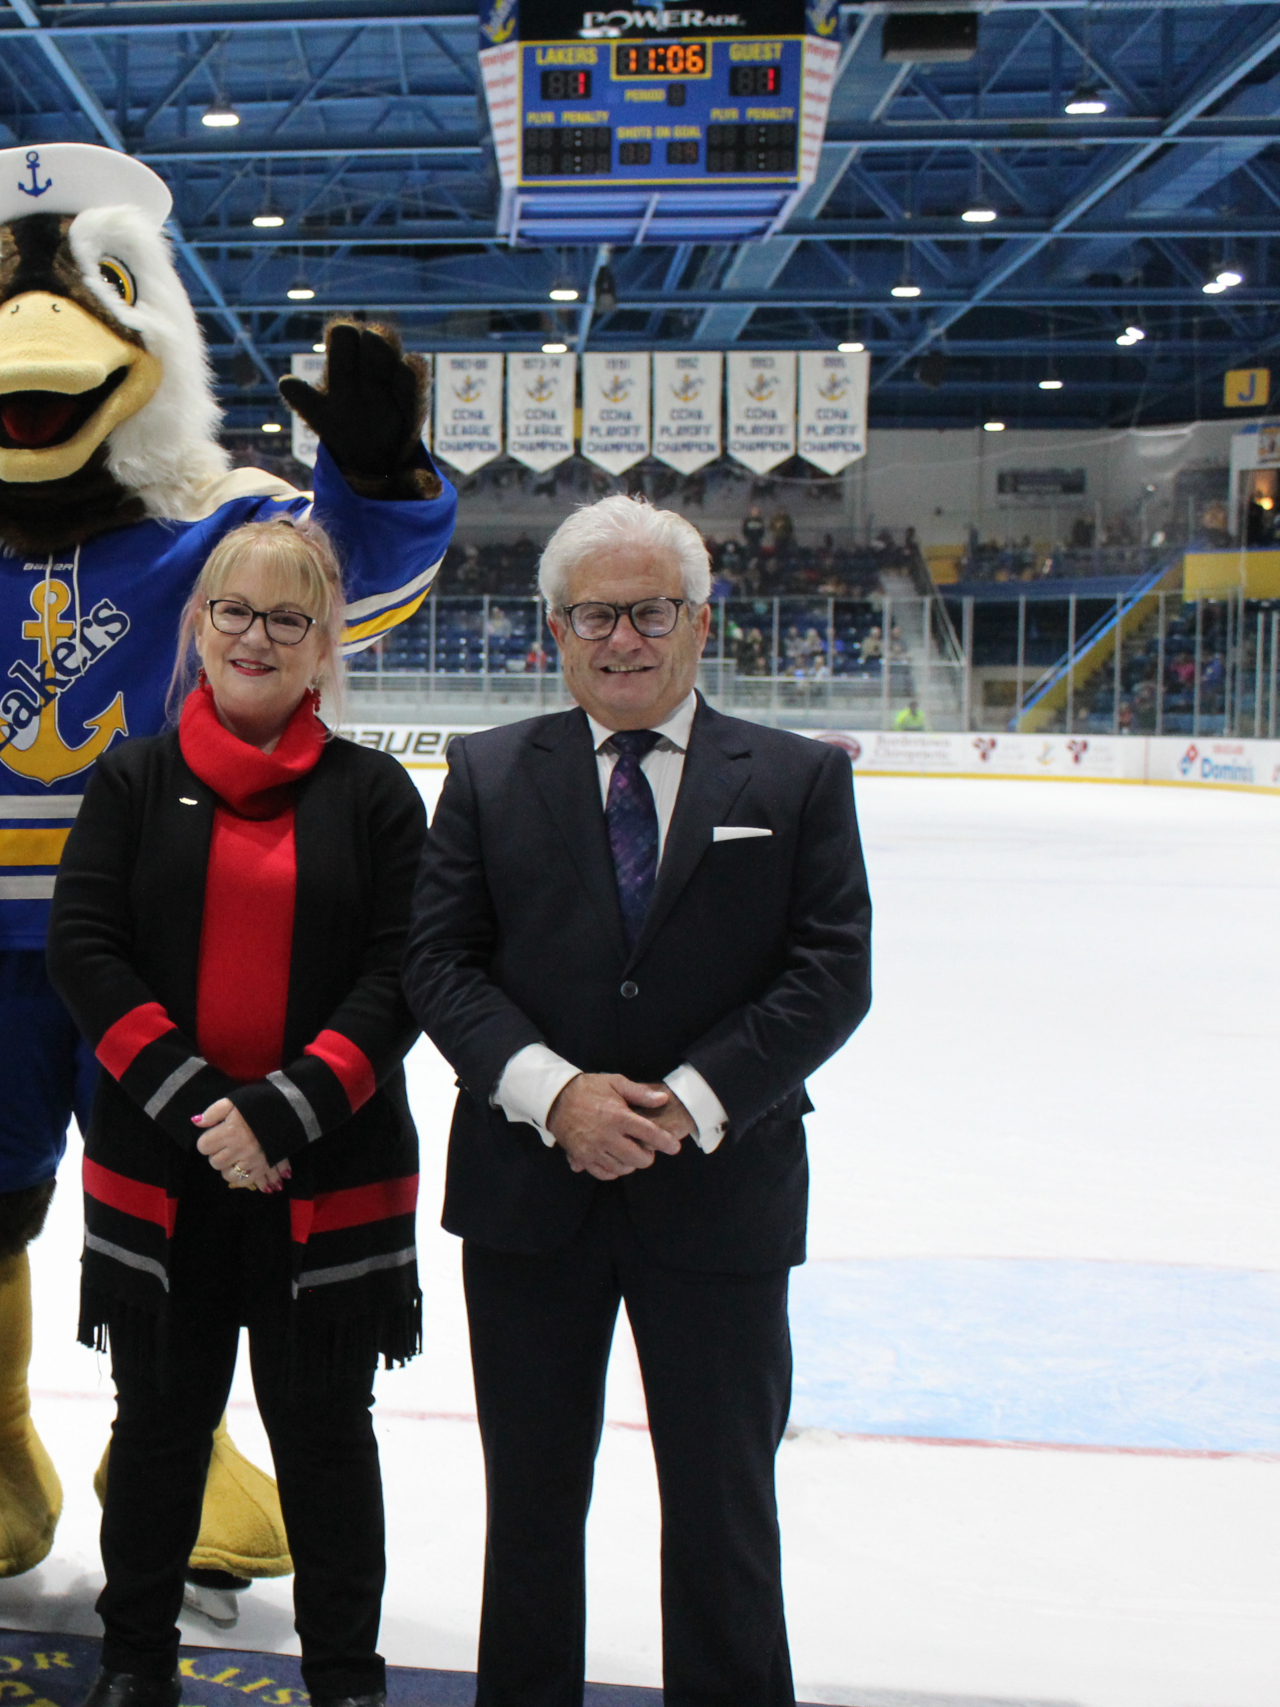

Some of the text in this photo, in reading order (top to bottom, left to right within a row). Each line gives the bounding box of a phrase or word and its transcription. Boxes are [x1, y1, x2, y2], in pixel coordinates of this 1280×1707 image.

[535, 47, 598, 65] LAKERS
[629, 45, 704, 73] 11:06
[729, 43, 783, 61] GUEST
[578, 72, 586, 94] 1
[768, 68, 776, 91] 1
[1237, 373, 1257, 402] J
[443, 424, 493, 436] LEAGUE
[517, 424, 564, 437] LEAGUE
